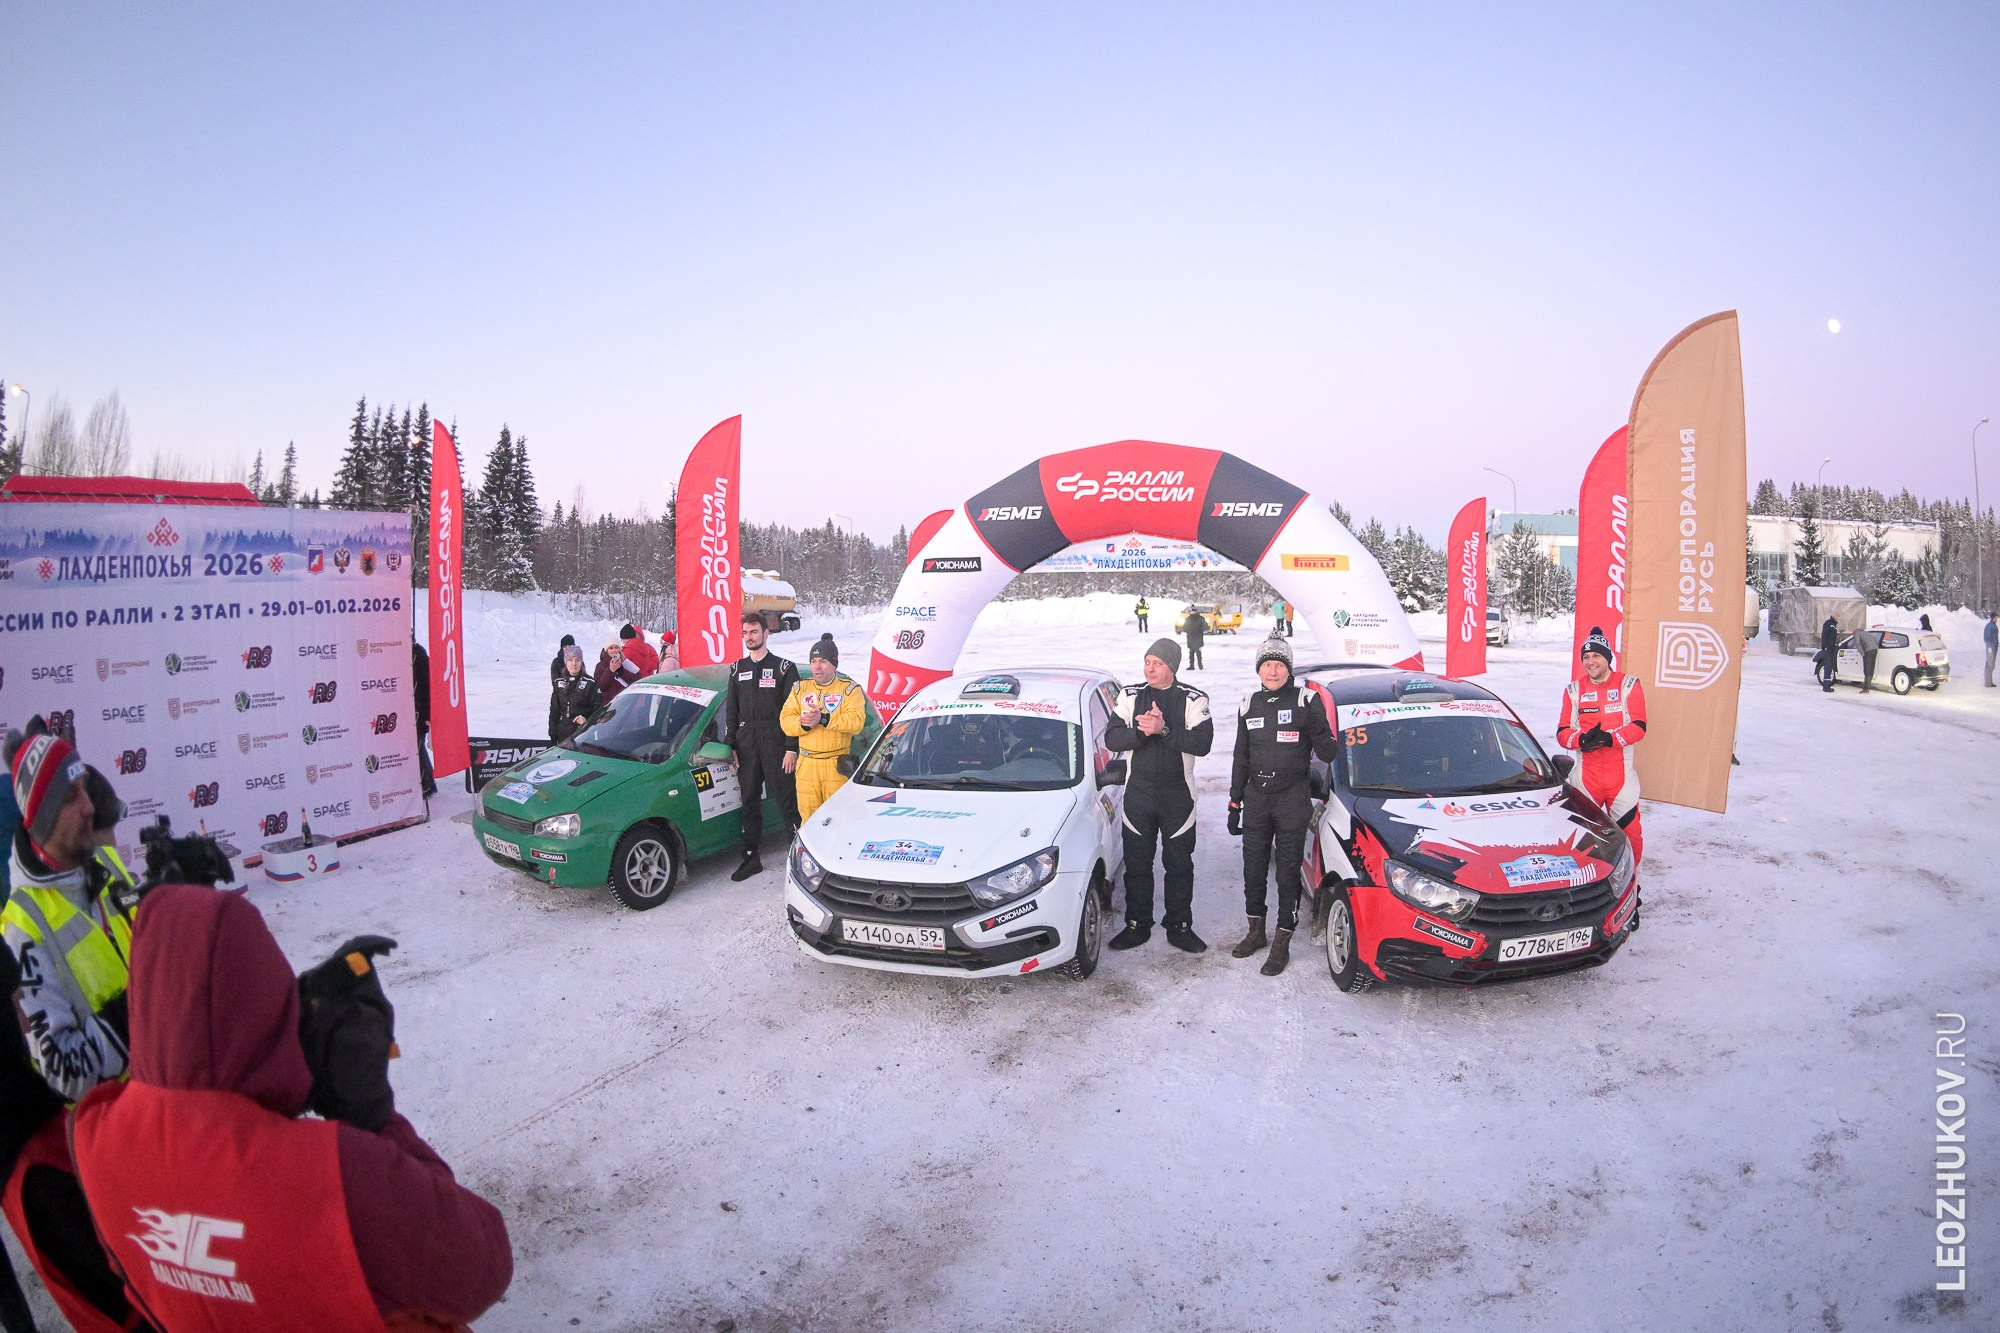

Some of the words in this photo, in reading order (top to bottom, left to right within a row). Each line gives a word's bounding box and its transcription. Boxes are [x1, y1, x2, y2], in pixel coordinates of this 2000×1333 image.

[1105, 470, 1185, 486] РАЛЛИ
[1099, 487, 1195, 502] РОССИИ
[984, 505, 1043, 521] ASMG
[1218, 502, 1284, 518] ASMG
[1679, 428, 1697, 612] КОРПОРАЦИЯ
[700, 493, 713, 600] РАЛЛИ
[714, 476, 731, 604] РОССИИ
[1121, 548, 1147, 557] 2026
[57, 554, 192, 583] ЛАХДЕНПОХЬЯ
[204, 553, 263, 576] 2026
[936, 560, 979, 570] YOKOHAMA
[1096, 558, 1172, 571] ЛАХДЕНПОХЬЯ
[1293, 557, 1336, 568] PIRELLI
[1698, 541, 1714, 613] РУСЬ
[52, 610, 78, 629] ПО
[86, 607, 153, 626] РАЛЛИ
[174, 606, 184, 621] 2
[191, 603, 241, 620] ЭТАП
[261, 597, 401, 617] 29.01-01.02.2026
[895, 606, 937, 617] SPACE
[896, 629, 926, 650] R8
[246, 645, 273, 669] R8
[299, 644, 337, 657] SPACE
[32, 664, 74, 681] SPACE
[312, 681, 337, 704] R8
[361, 677, 398, 691] SPACE
[102, 705, 145, 721] SPACE
[920, 703, 983, 713] ТАТНЕФТЬ
[1013, 707, 1061, 715] РОССИИ
[1363, 705, 1432, 717] ТАТНЕФТЬ
[374, 712, 397, 735] R8
[1345, 727, 1368, 746] 35
[175, 741, 217, 758] SPACE
[120, 748, 147, 775] R8
[245, 773, 286, 790] SPACE
[694, 771, 710, 788] 37
[194, 781, 220, 808] R8
[313, 800, 351, 818] SPACE
[264, 811, 288, 837] R8
[895, 841, 913, 849] 34
[307, 854, 318, 872] 3
[870, 853, 926, 863] ЛАХДЕНПОХЬЯ
[1530, 857, 1545, 865] 35
[1520, 870, 1571, 882] ЛАХДЕНПОХЬЯ
[995, 902, 1036, 925] YOKOHAMA
[920, 930, 937, 943] 59
[1430, 926, 1470, 947] YOKOHAMA
[1569, 930, 1588, 944] 196
